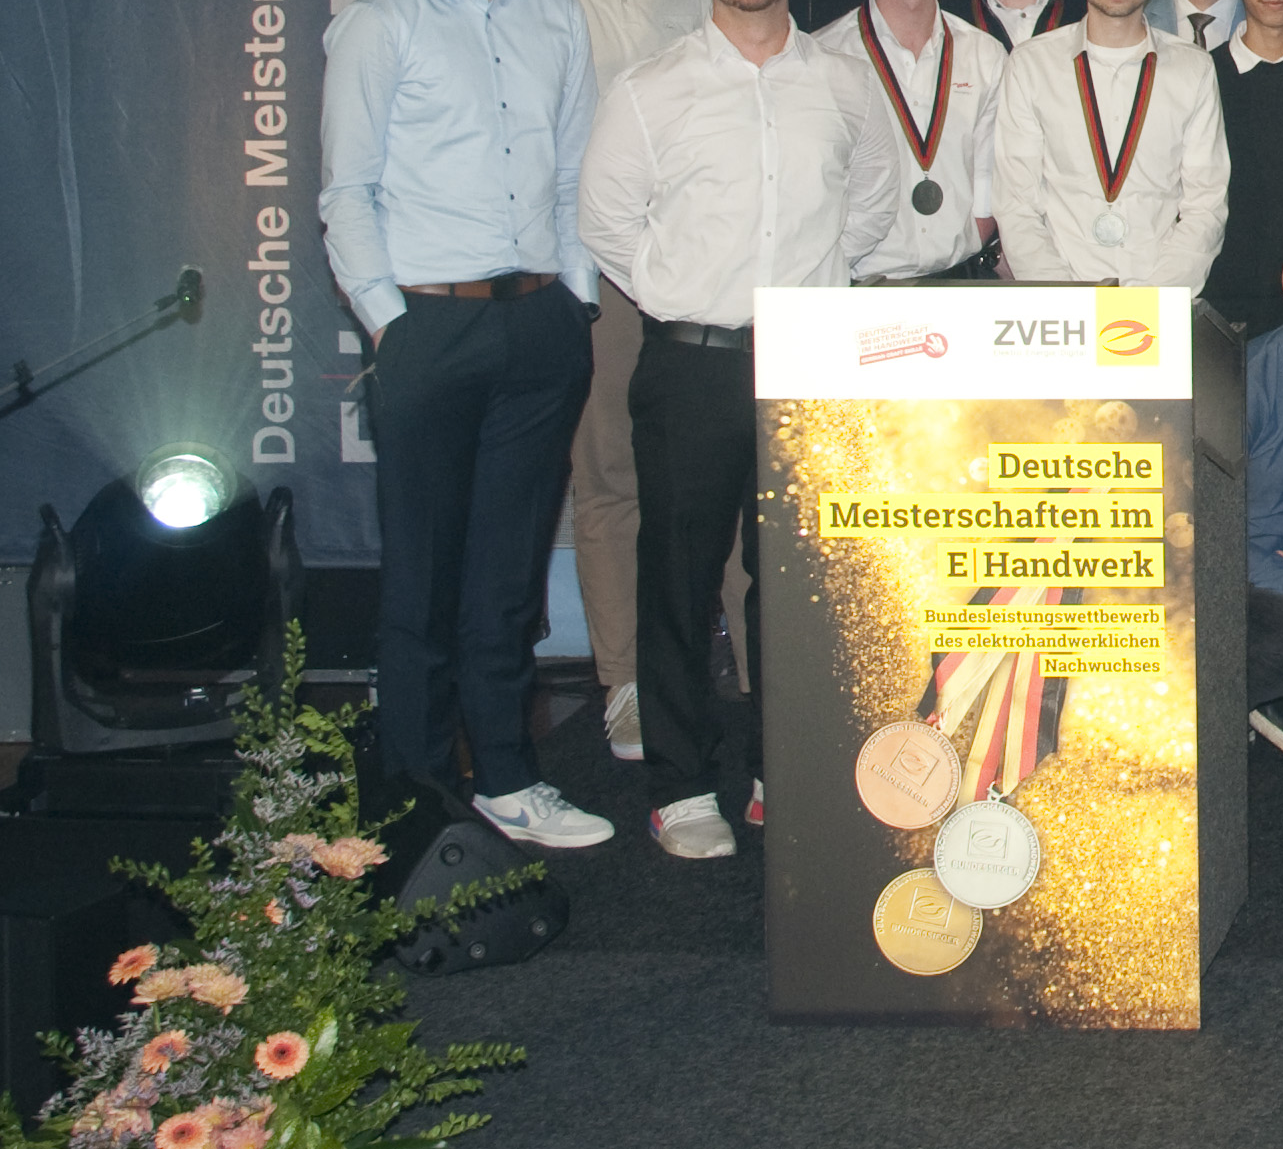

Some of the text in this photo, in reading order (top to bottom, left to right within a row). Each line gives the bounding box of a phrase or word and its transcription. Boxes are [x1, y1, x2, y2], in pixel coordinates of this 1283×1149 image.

[249, 207, 297, 464] Deutsche
[994, 320, 1085, 345] ZVEH
[1000, 453, 1152, 478] Deutsche
[830, 502, 1153, 528] Meisterschaften im
[925, 609, 1160, 627] Bundesleistungswettbewerb
[934, 634, 1160, 649] des elektrohandwerklichen
[1044, 658, 1160, 673] Nachwuchses
